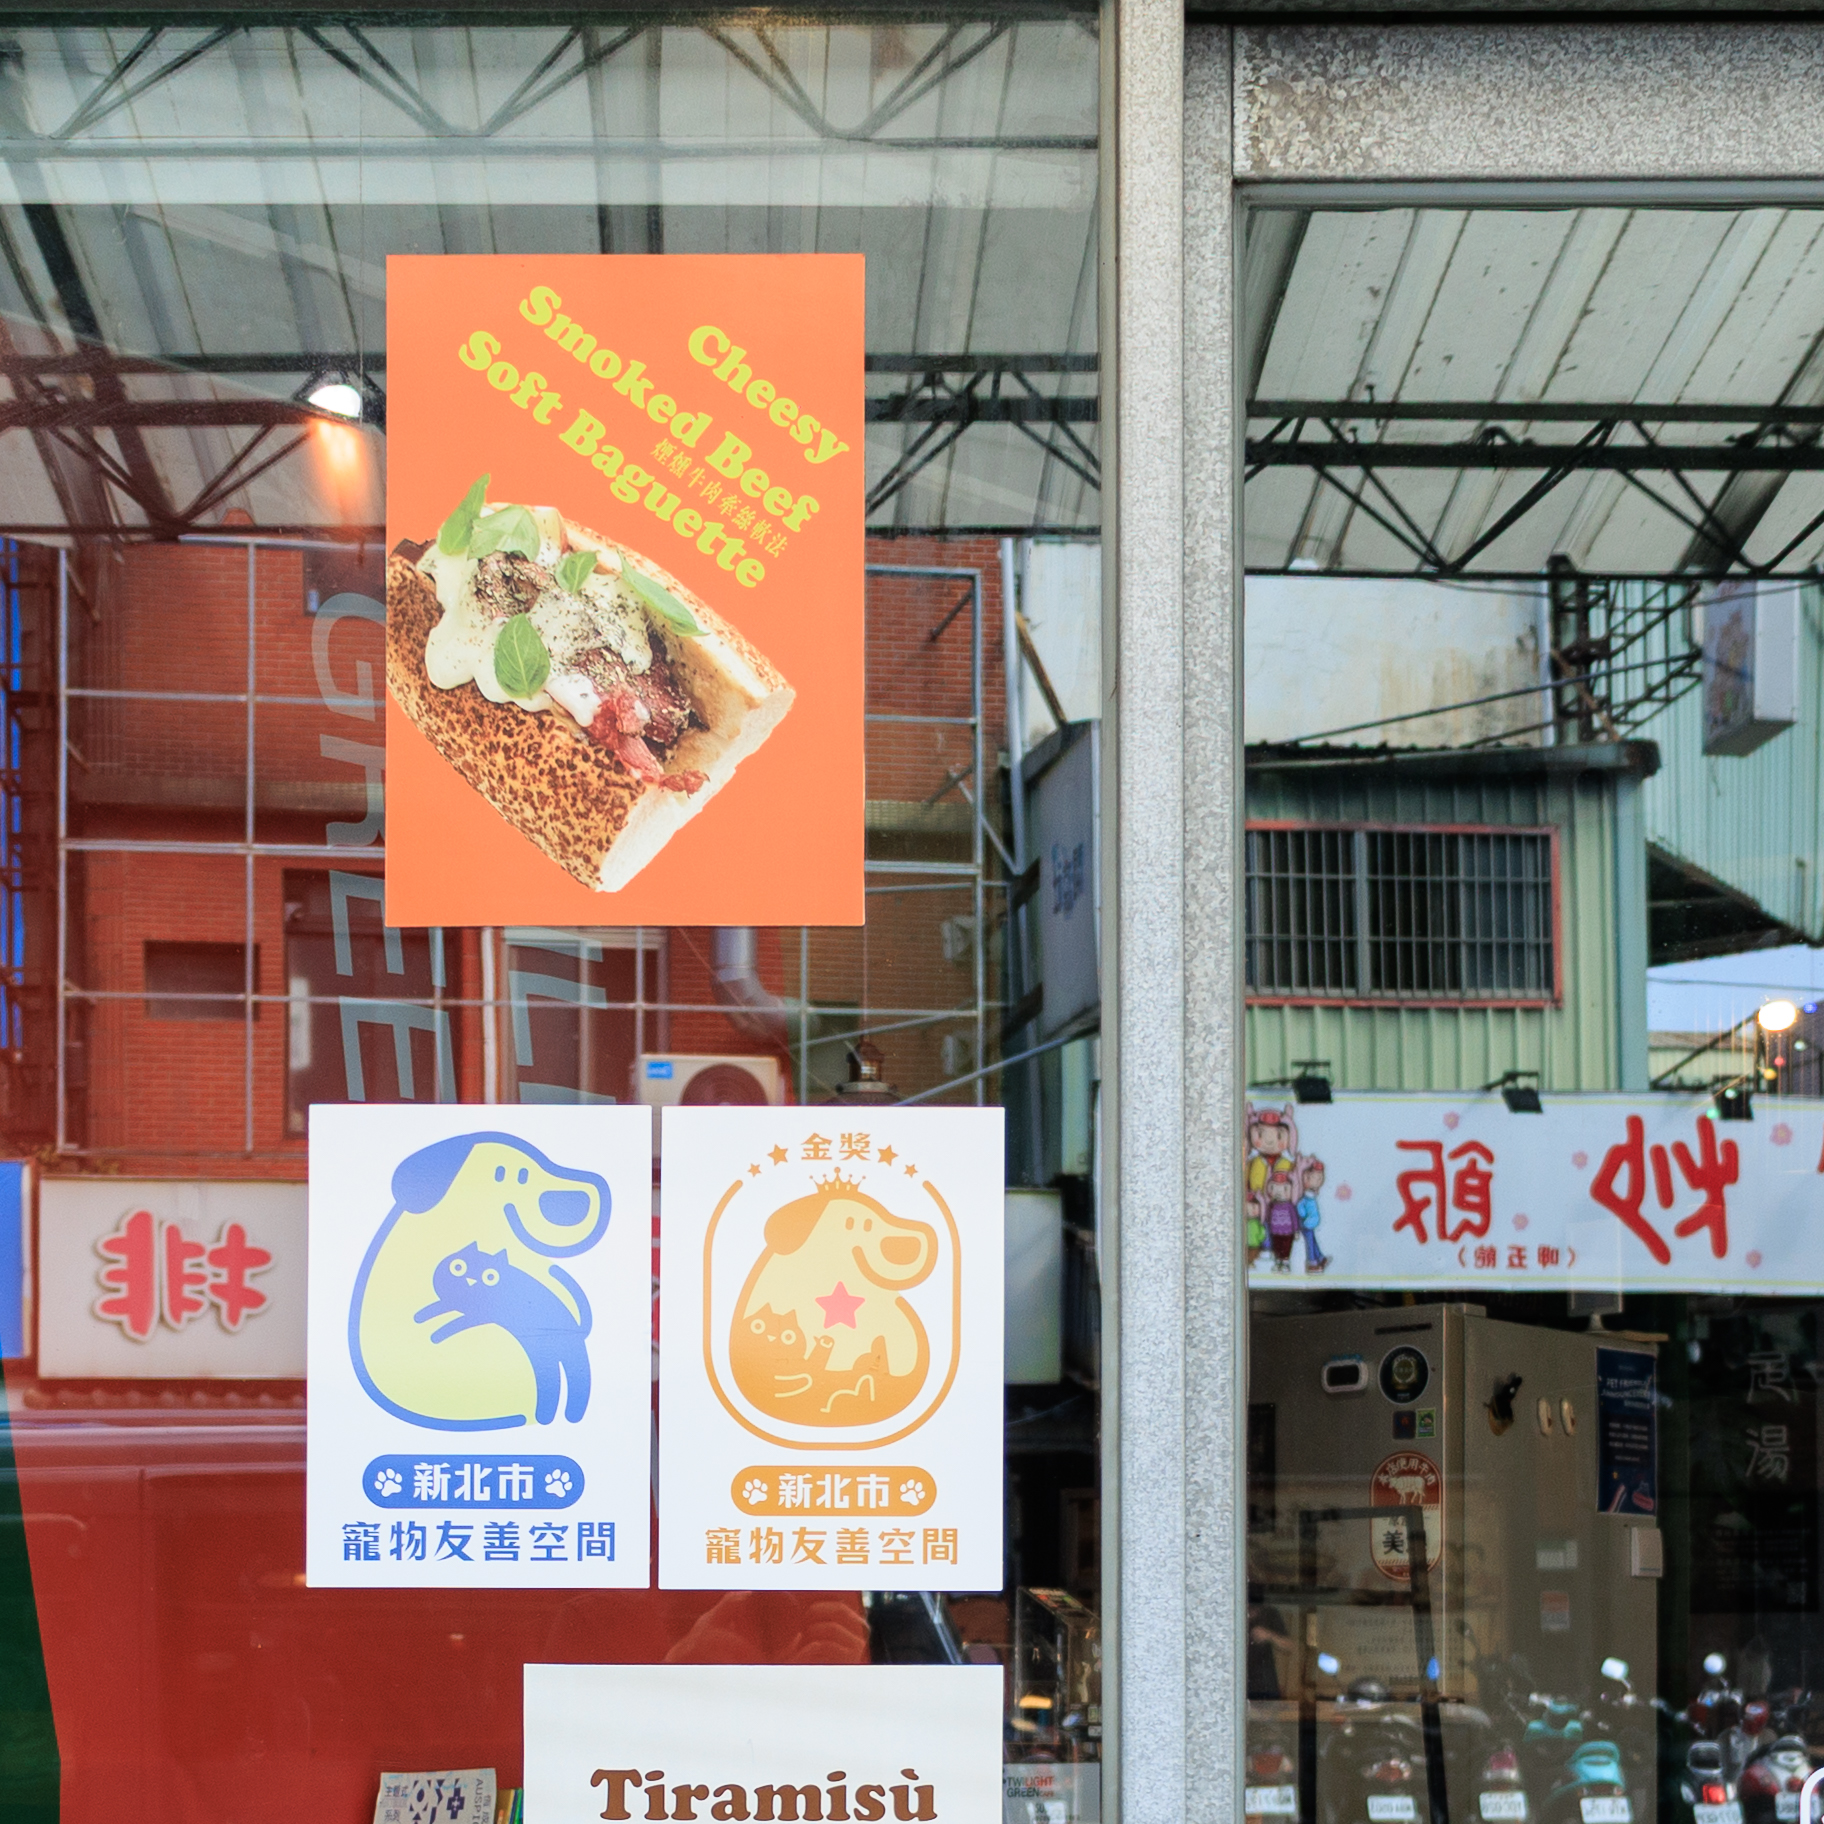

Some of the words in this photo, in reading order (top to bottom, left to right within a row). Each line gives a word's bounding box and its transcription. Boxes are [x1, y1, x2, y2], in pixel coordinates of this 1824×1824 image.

[519, 285, 713, 449] Smoked
[705, 431, 820, 533] Beef
[688, 324, 850, 464] Cheesy
[458, 330, 564, 424] Soft
[559, 409, 767, 588] Baguette
[800, 1132, 873, 1162] 金獎
[412, 1462, 536, 1502] 新北市
[777, 1472, 891, 1511] 新北市
[341, 1520, 616, 1563] 寵物友善空間
[705, 1526, 959, 1566] 寵物友善空間
[590, 1768, 939, 1823] Tiramisù
